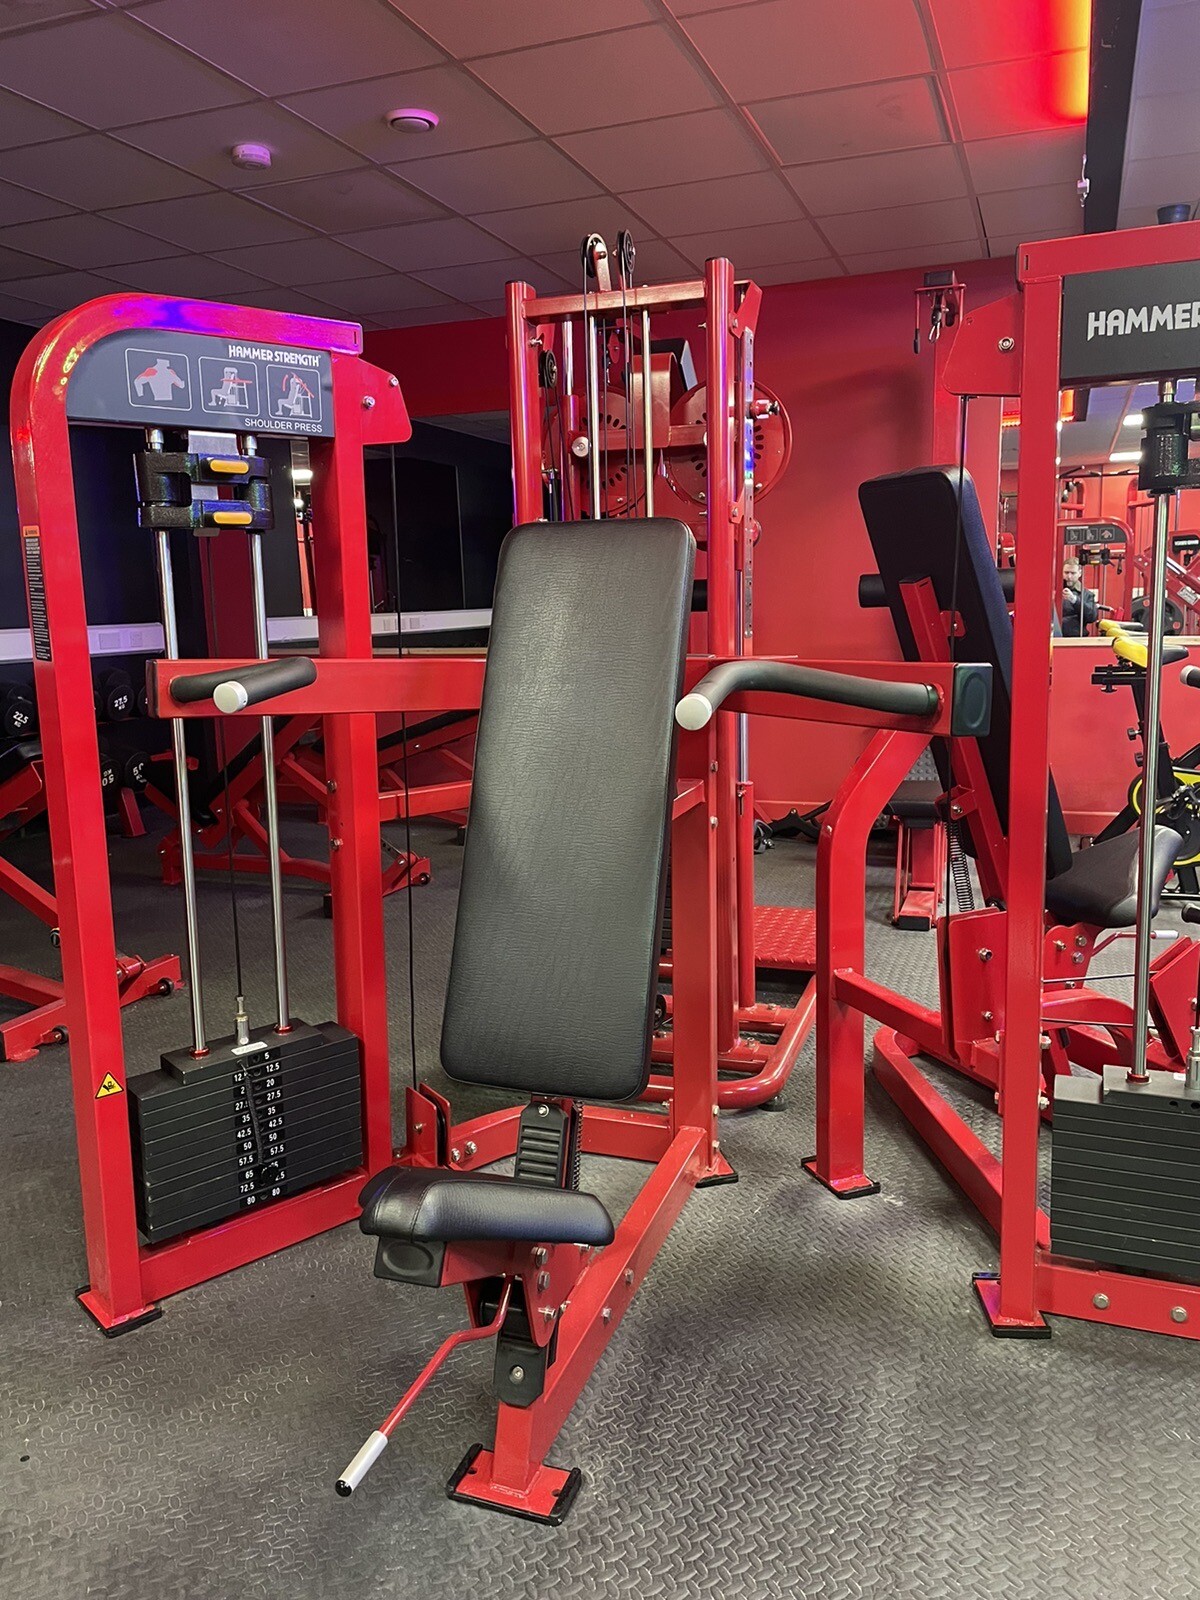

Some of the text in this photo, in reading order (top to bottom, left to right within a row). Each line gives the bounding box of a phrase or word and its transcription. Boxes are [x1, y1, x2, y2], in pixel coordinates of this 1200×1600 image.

[228, 345, 320, 367] HAMMER STRENGTH
[244, 417, 323, 433] SHOULDER PRESS
[12, 711, 29, 724] 22.5
[264, 1051, 270, 1060] 5
[265, 1062, 280, 1073] 12.5
[266, 1078, 275, 1088] 20
[266, 1089, 281, 1101] 27.5
[267, 1106, 276, 1116] 35
[241, 1113, 251, 1123] 35
[268, 1117, 283, 1128] 42.5
[237, 1127, 252, 1139] 42.5
[268, 1132, 278, 1142] 50
[243, 1141, 252, 1151] 50
[270, 1144, 285, 1156] 57.5
[239, 1154, 254, 1167] 57.5
[245, 1169, 254, 1179] 65
[240, 1181, 255, 1193] 72.5
[271, 1187, 281, 1197] 80
[246, 1196, 256, 1206] 80
